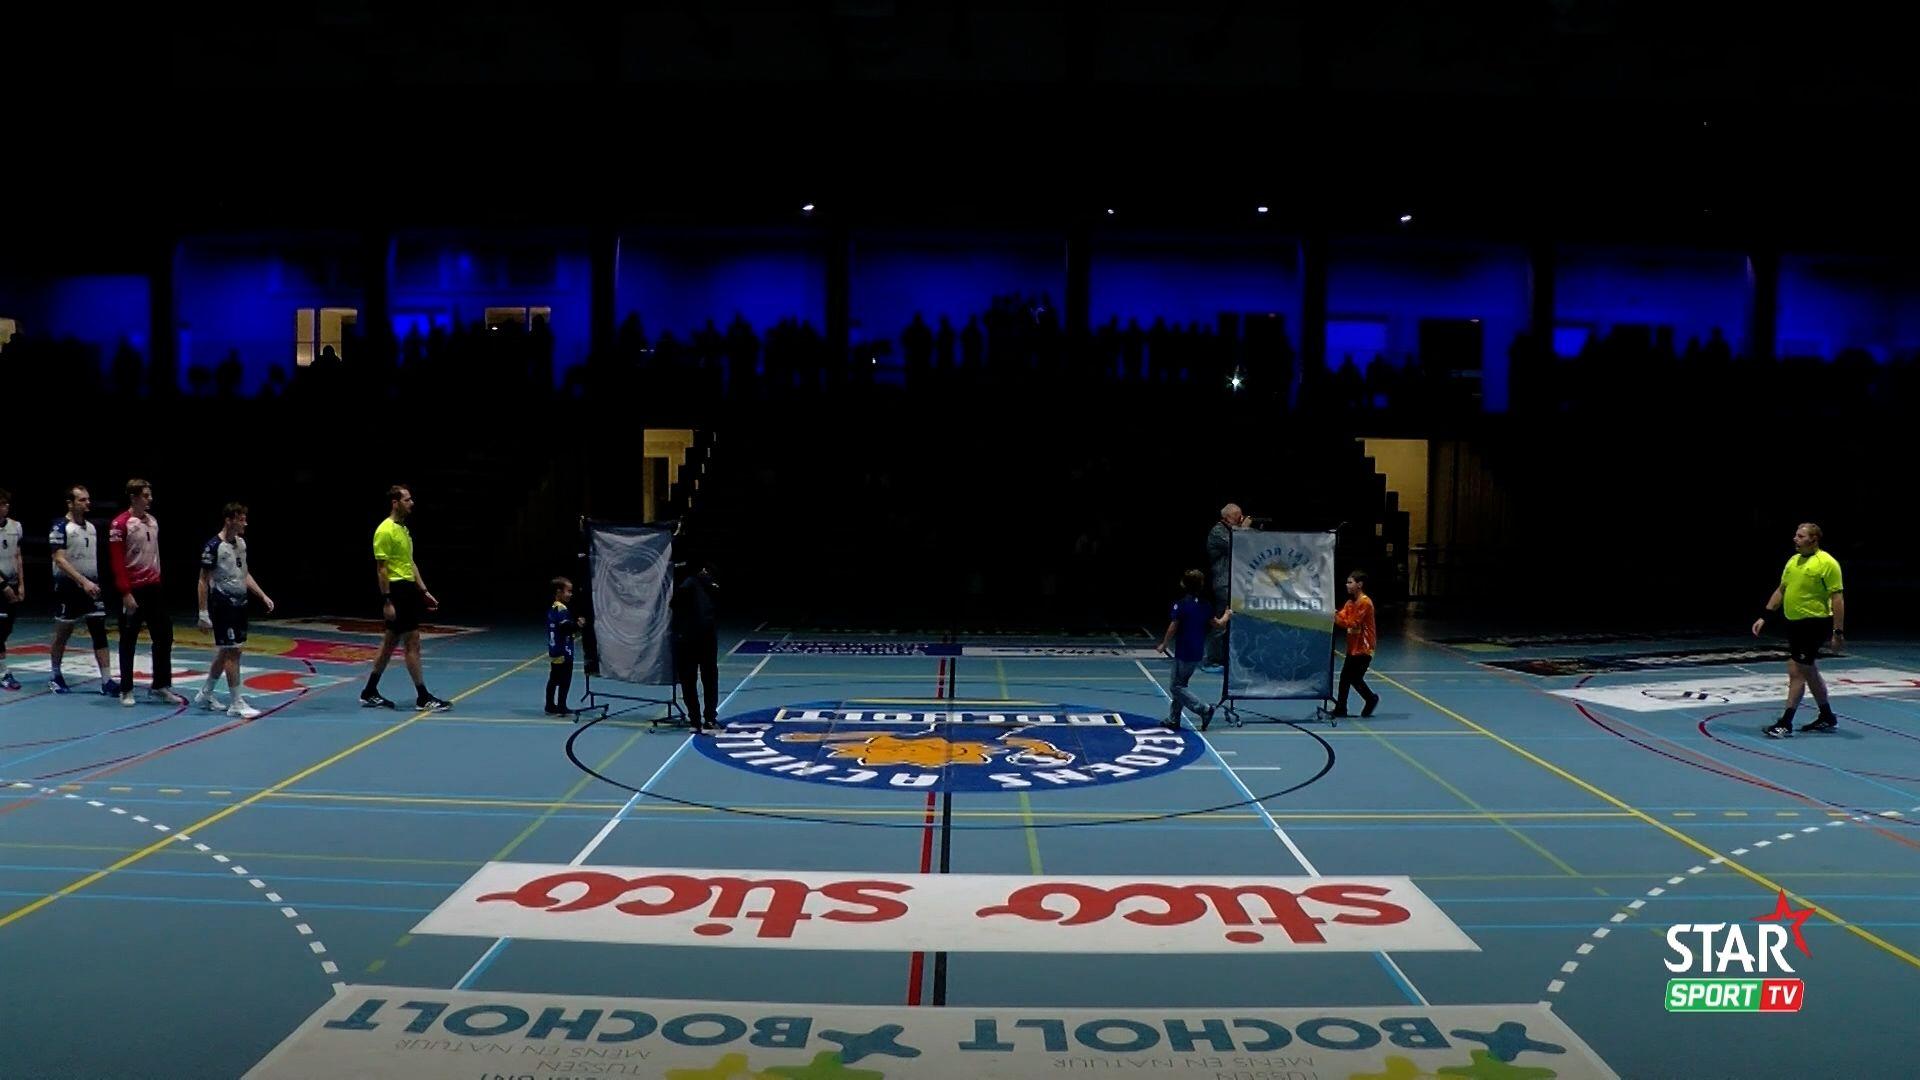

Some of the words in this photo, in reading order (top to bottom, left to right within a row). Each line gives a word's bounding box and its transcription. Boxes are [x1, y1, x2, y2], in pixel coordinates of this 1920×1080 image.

[788, 708, 1108, 726] BOCHOLT
[476, 871, 913, 939] stico
[976, 882, 1411, 945] stico
[323, 998, 812, 1050] BOCHOLT
[958, 1016, 1453, 1053] BOCHOLT
[394, 1038, 511, 1054] NATUUR
[536, 1060, 641, 1076] TUSSEN
[1053, 1055, 1174, 1068] NATUUR
[1185, 1055, 1224, 1068] EN
[1234, 1055, 1315, 1068] MENS
